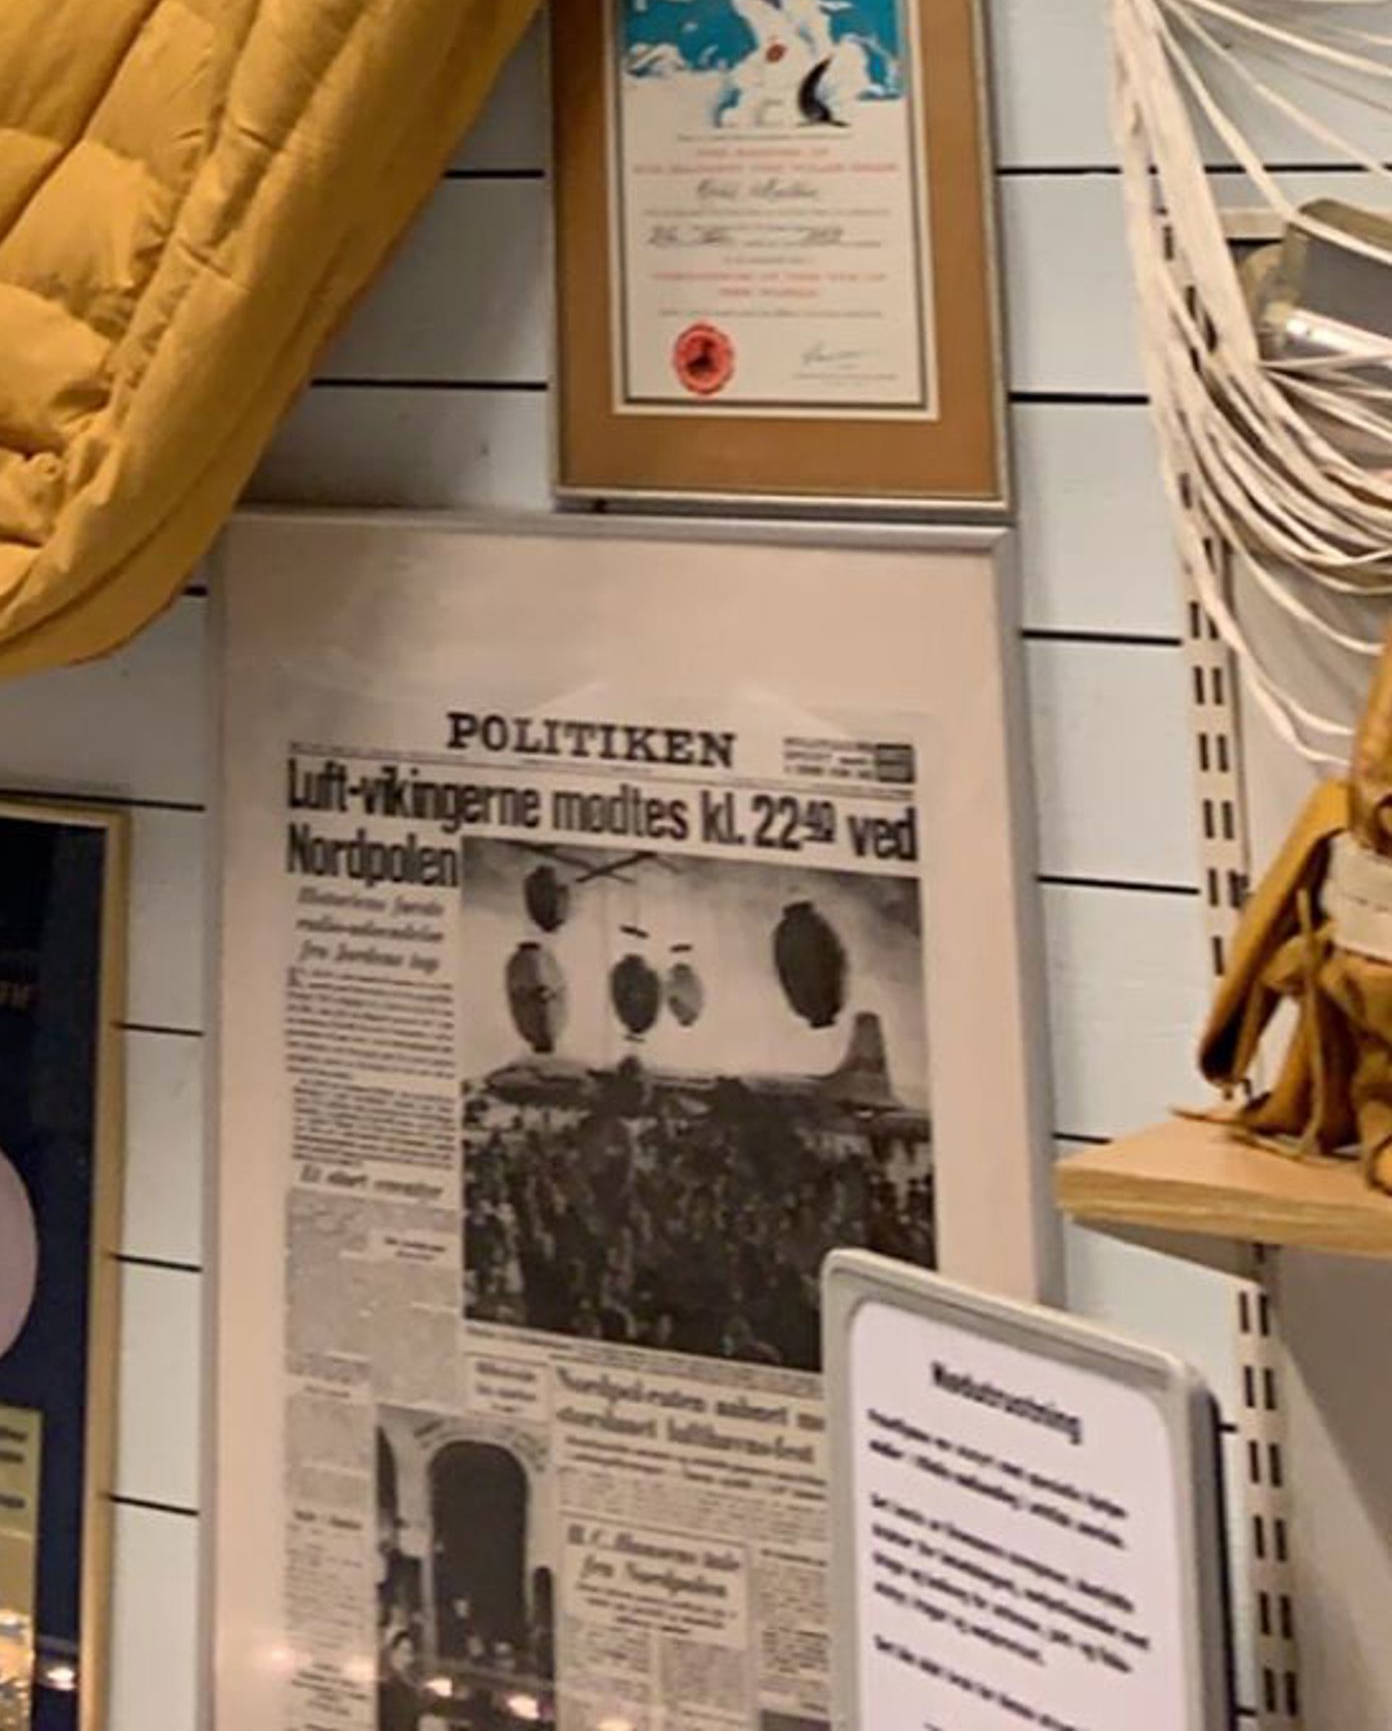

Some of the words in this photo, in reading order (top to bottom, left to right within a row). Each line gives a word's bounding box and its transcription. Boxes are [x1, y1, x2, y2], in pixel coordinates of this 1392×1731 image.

[446, 712, 736, 769] POLITIKEN
[287, 821, 458, 888] Nordpolen
[847, 807, 919, 862] ved
